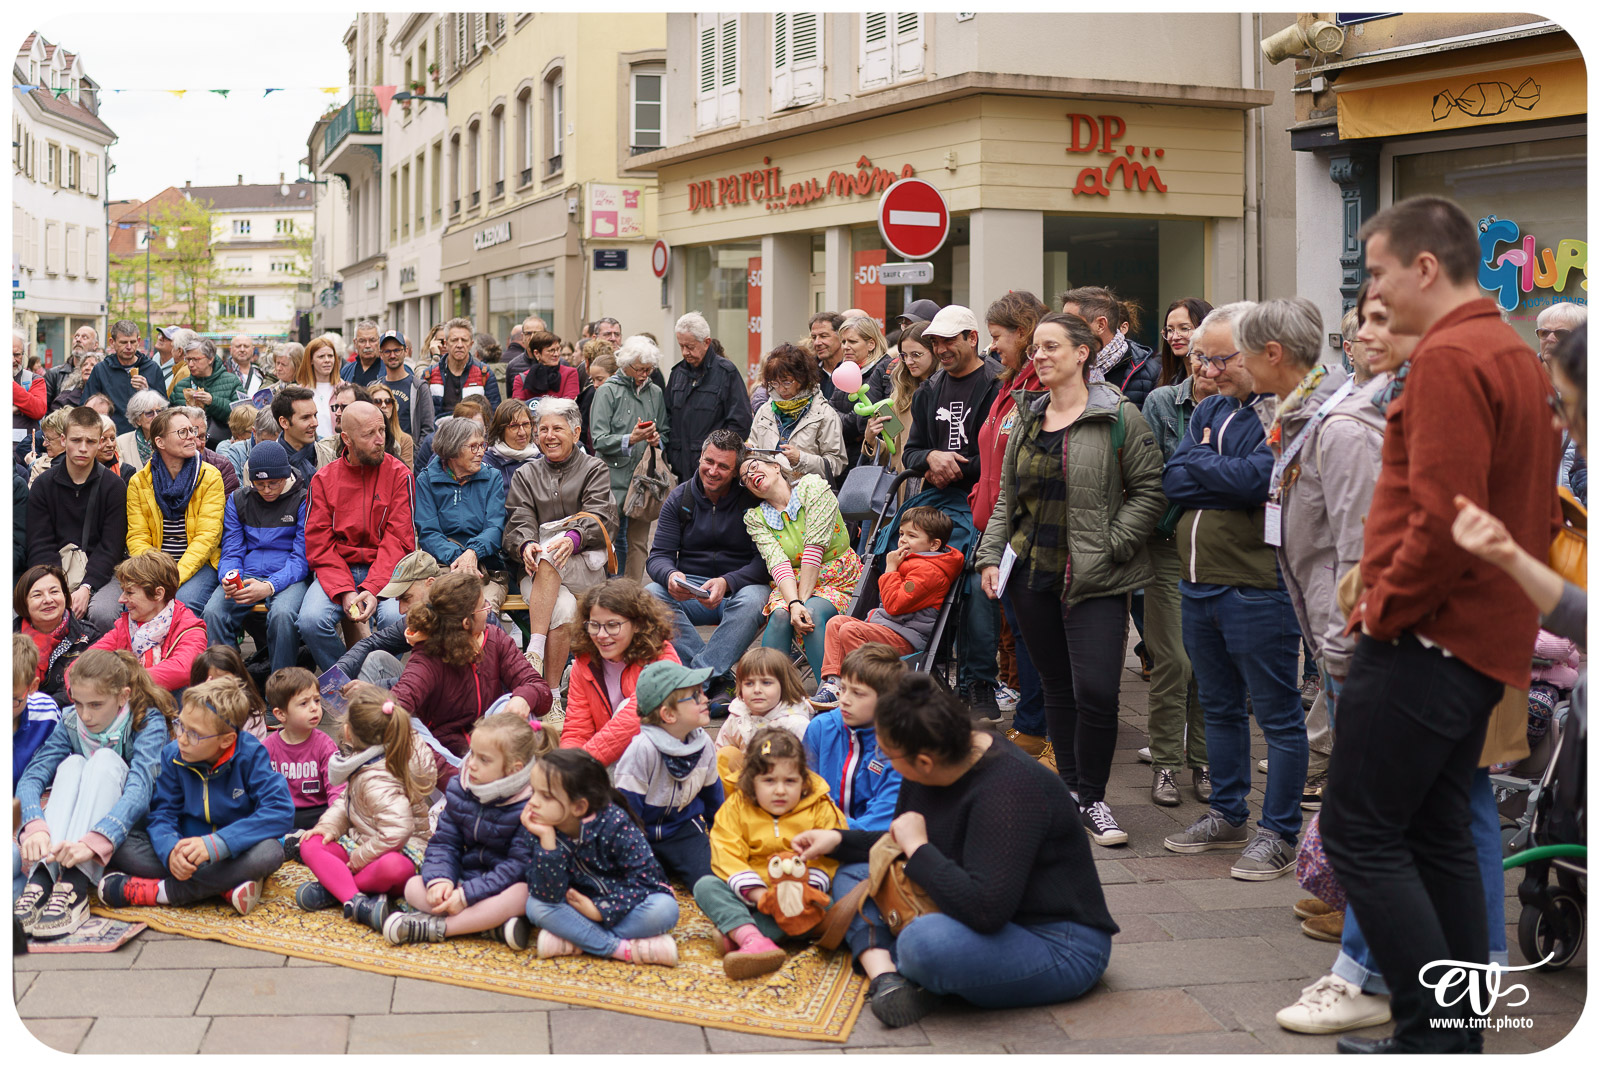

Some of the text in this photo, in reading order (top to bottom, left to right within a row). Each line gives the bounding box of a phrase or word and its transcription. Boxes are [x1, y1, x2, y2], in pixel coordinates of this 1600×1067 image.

[1072, 156, 1168, 197] am
[855, 265, 880, 285] -50
[1521, 297, 1550, 310] 100%
